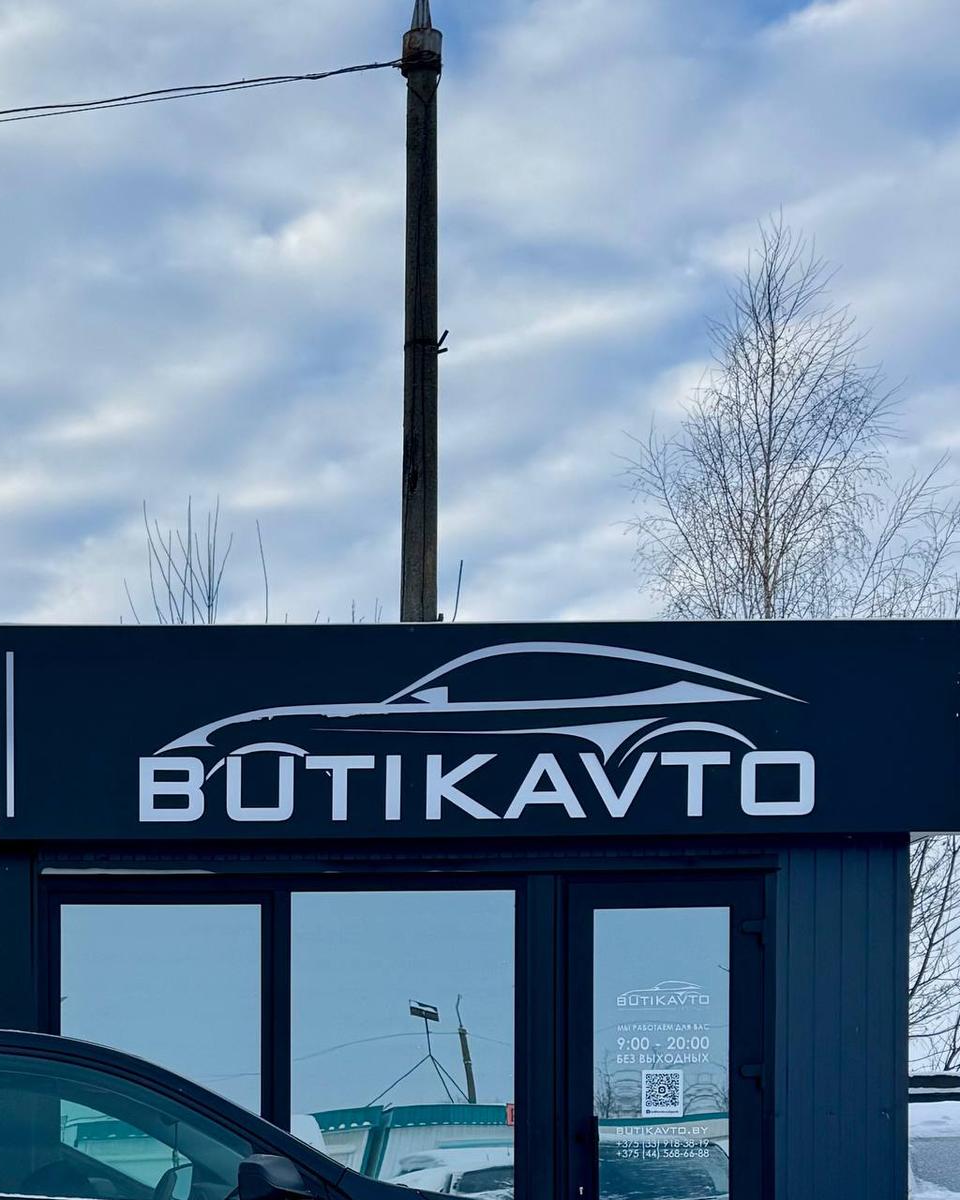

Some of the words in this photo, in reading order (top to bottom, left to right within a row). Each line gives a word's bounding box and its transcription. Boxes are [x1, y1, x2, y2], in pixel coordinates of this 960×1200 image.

[138, 750, 816, 823] BUTIKAVTO
[616, 995, 710, 1006] BUTIKAVTO
[632, 1024, 674, 1032] РАБОТАЕМ
[616, 1037, 650, 1050] 9:00
[667, 1036, 710, 1050] 20:00
[616, 1054, 636, 1064] БЕЗ
[639, 1053, 710, 1064] ВЫХОДНЫХ
[616, 1127, 709, 1135] BUTIKAVTO.BY
[616, 1150, 639, 1158] +375
[642, 1150, 660, 1159] (44)
